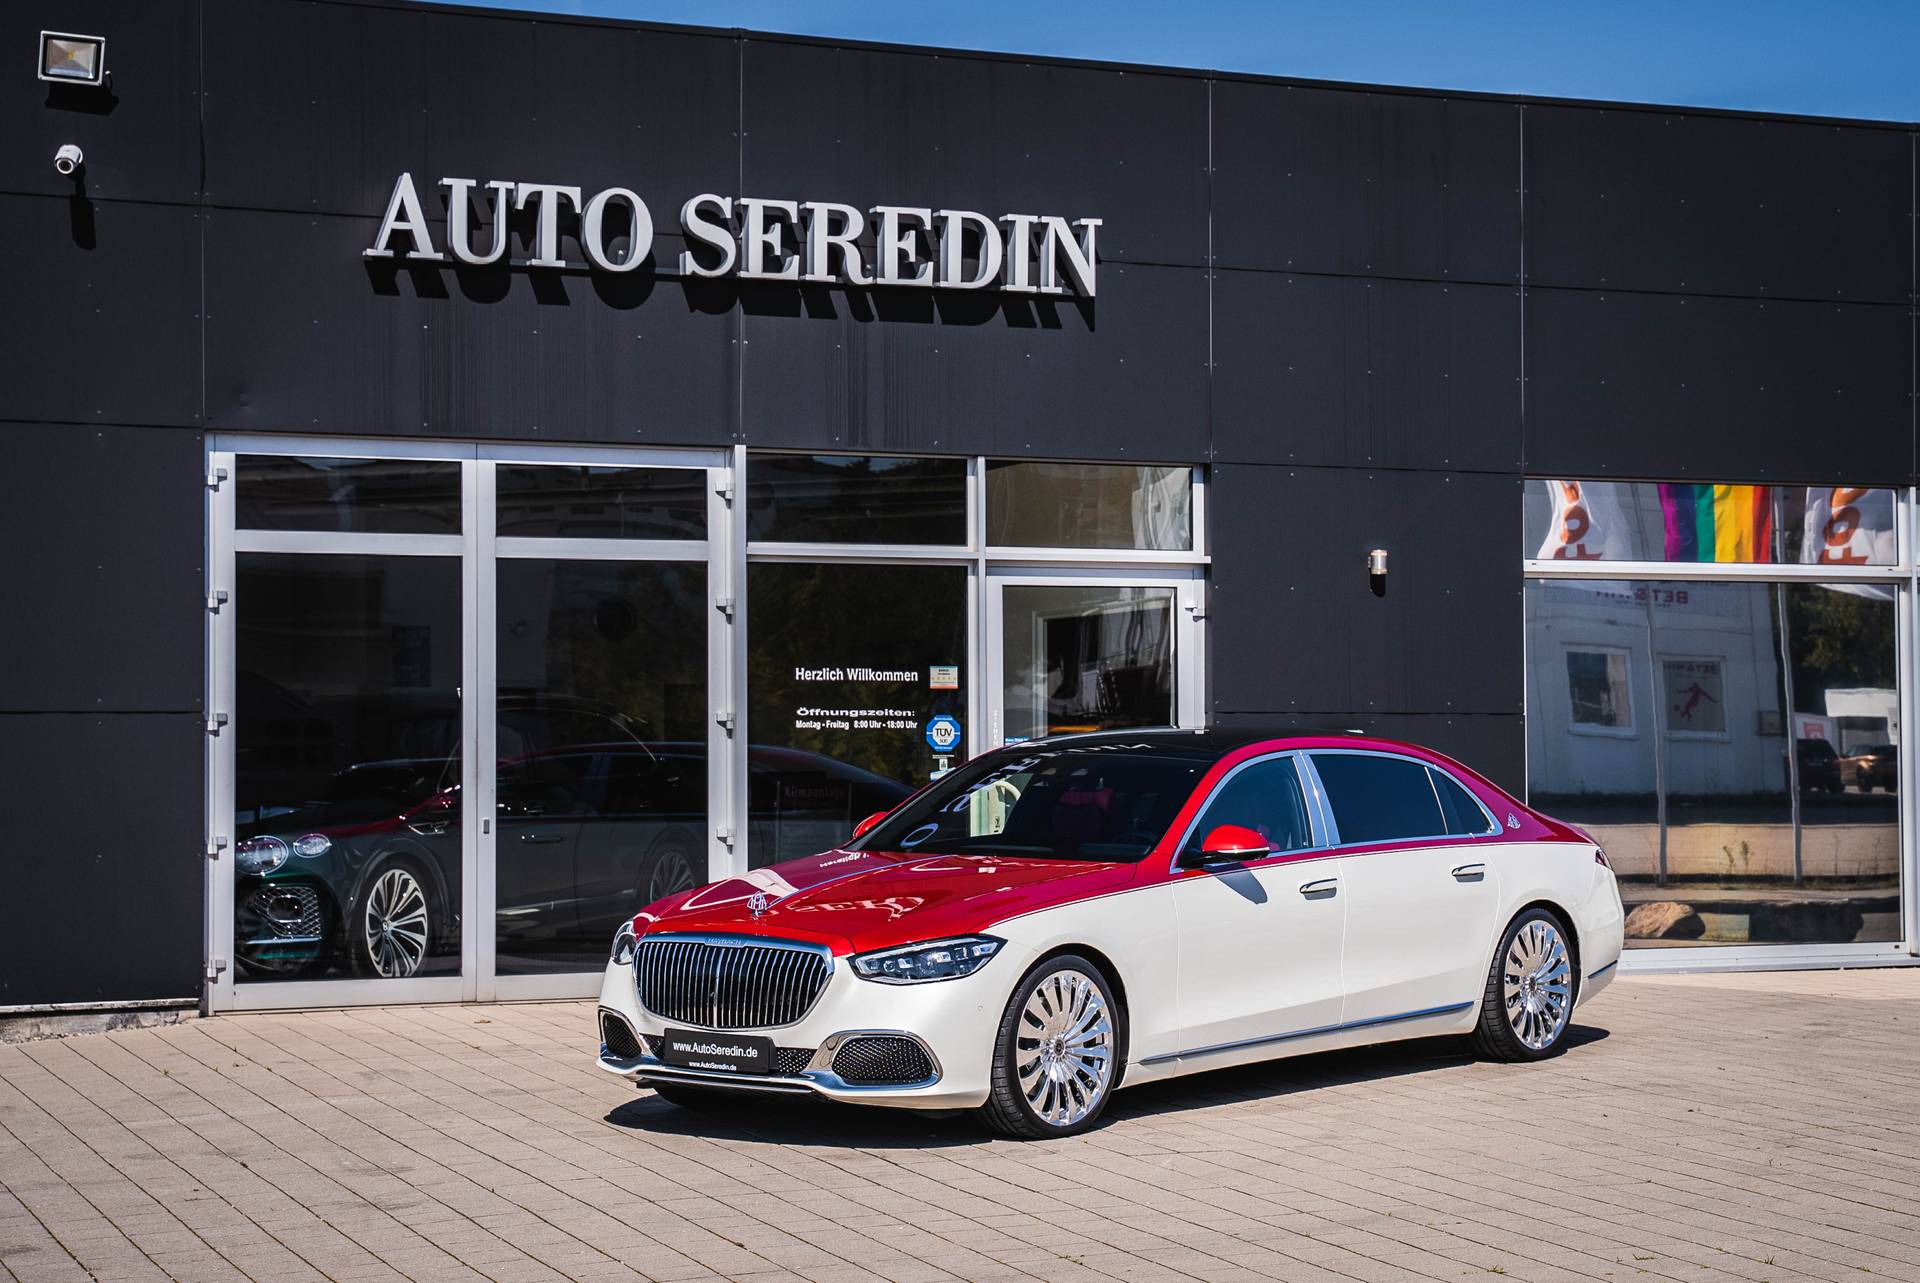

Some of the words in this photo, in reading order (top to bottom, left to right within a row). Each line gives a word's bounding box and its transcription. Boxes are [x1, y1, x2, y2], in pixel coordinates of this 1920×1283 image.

[363, 172, 654, 273] AUTO
[679, 193, 1104, 298] SEREDIN
[795, 667, 844, 681] Herzlich
[846, 668, 919, 682] Willkommen
[796, 707, 915, 717] Öffnungszeiten:
[796, 720, 821, 730] Montag
[826, 720, 849, 730] Freitag
[854, 720, 868, 729] 8:00
[869, 720, 882, 729] Uhr
[887, 720, 904, 729] 18:00
[905, 721, 918, 729] Uhr
[935, 728, 953, 737] TÜV
[673, 1042, 758, 1058] www.AutoSeredin.de
[688, 1060, 737, 1071] www.AutoSeredin.de
